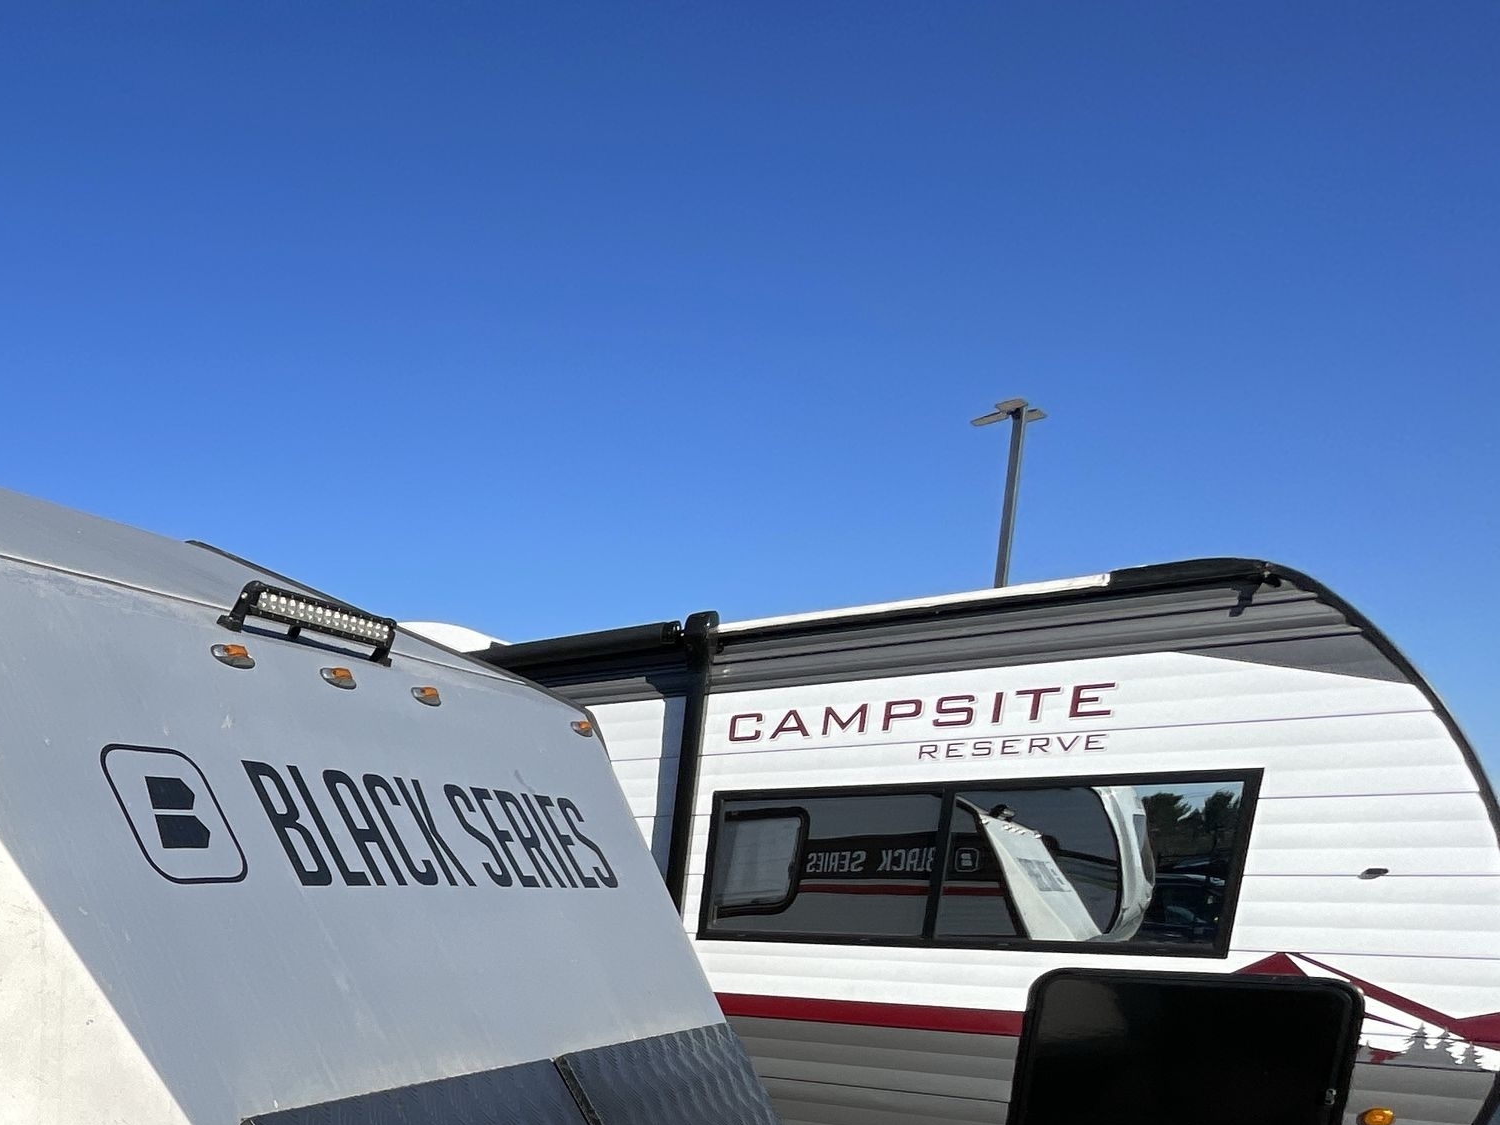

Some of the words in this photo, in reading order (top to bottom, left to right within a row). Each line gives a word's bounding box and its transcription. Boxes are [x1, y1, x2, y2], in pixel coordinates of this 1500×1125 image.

[728, 682, 1116, 742] CAMPSITE
[918, 733, 1108, 760] RESERVE
[241, 760, 477, 887] BLACK
[444, 784, 618, 888] SERIES
